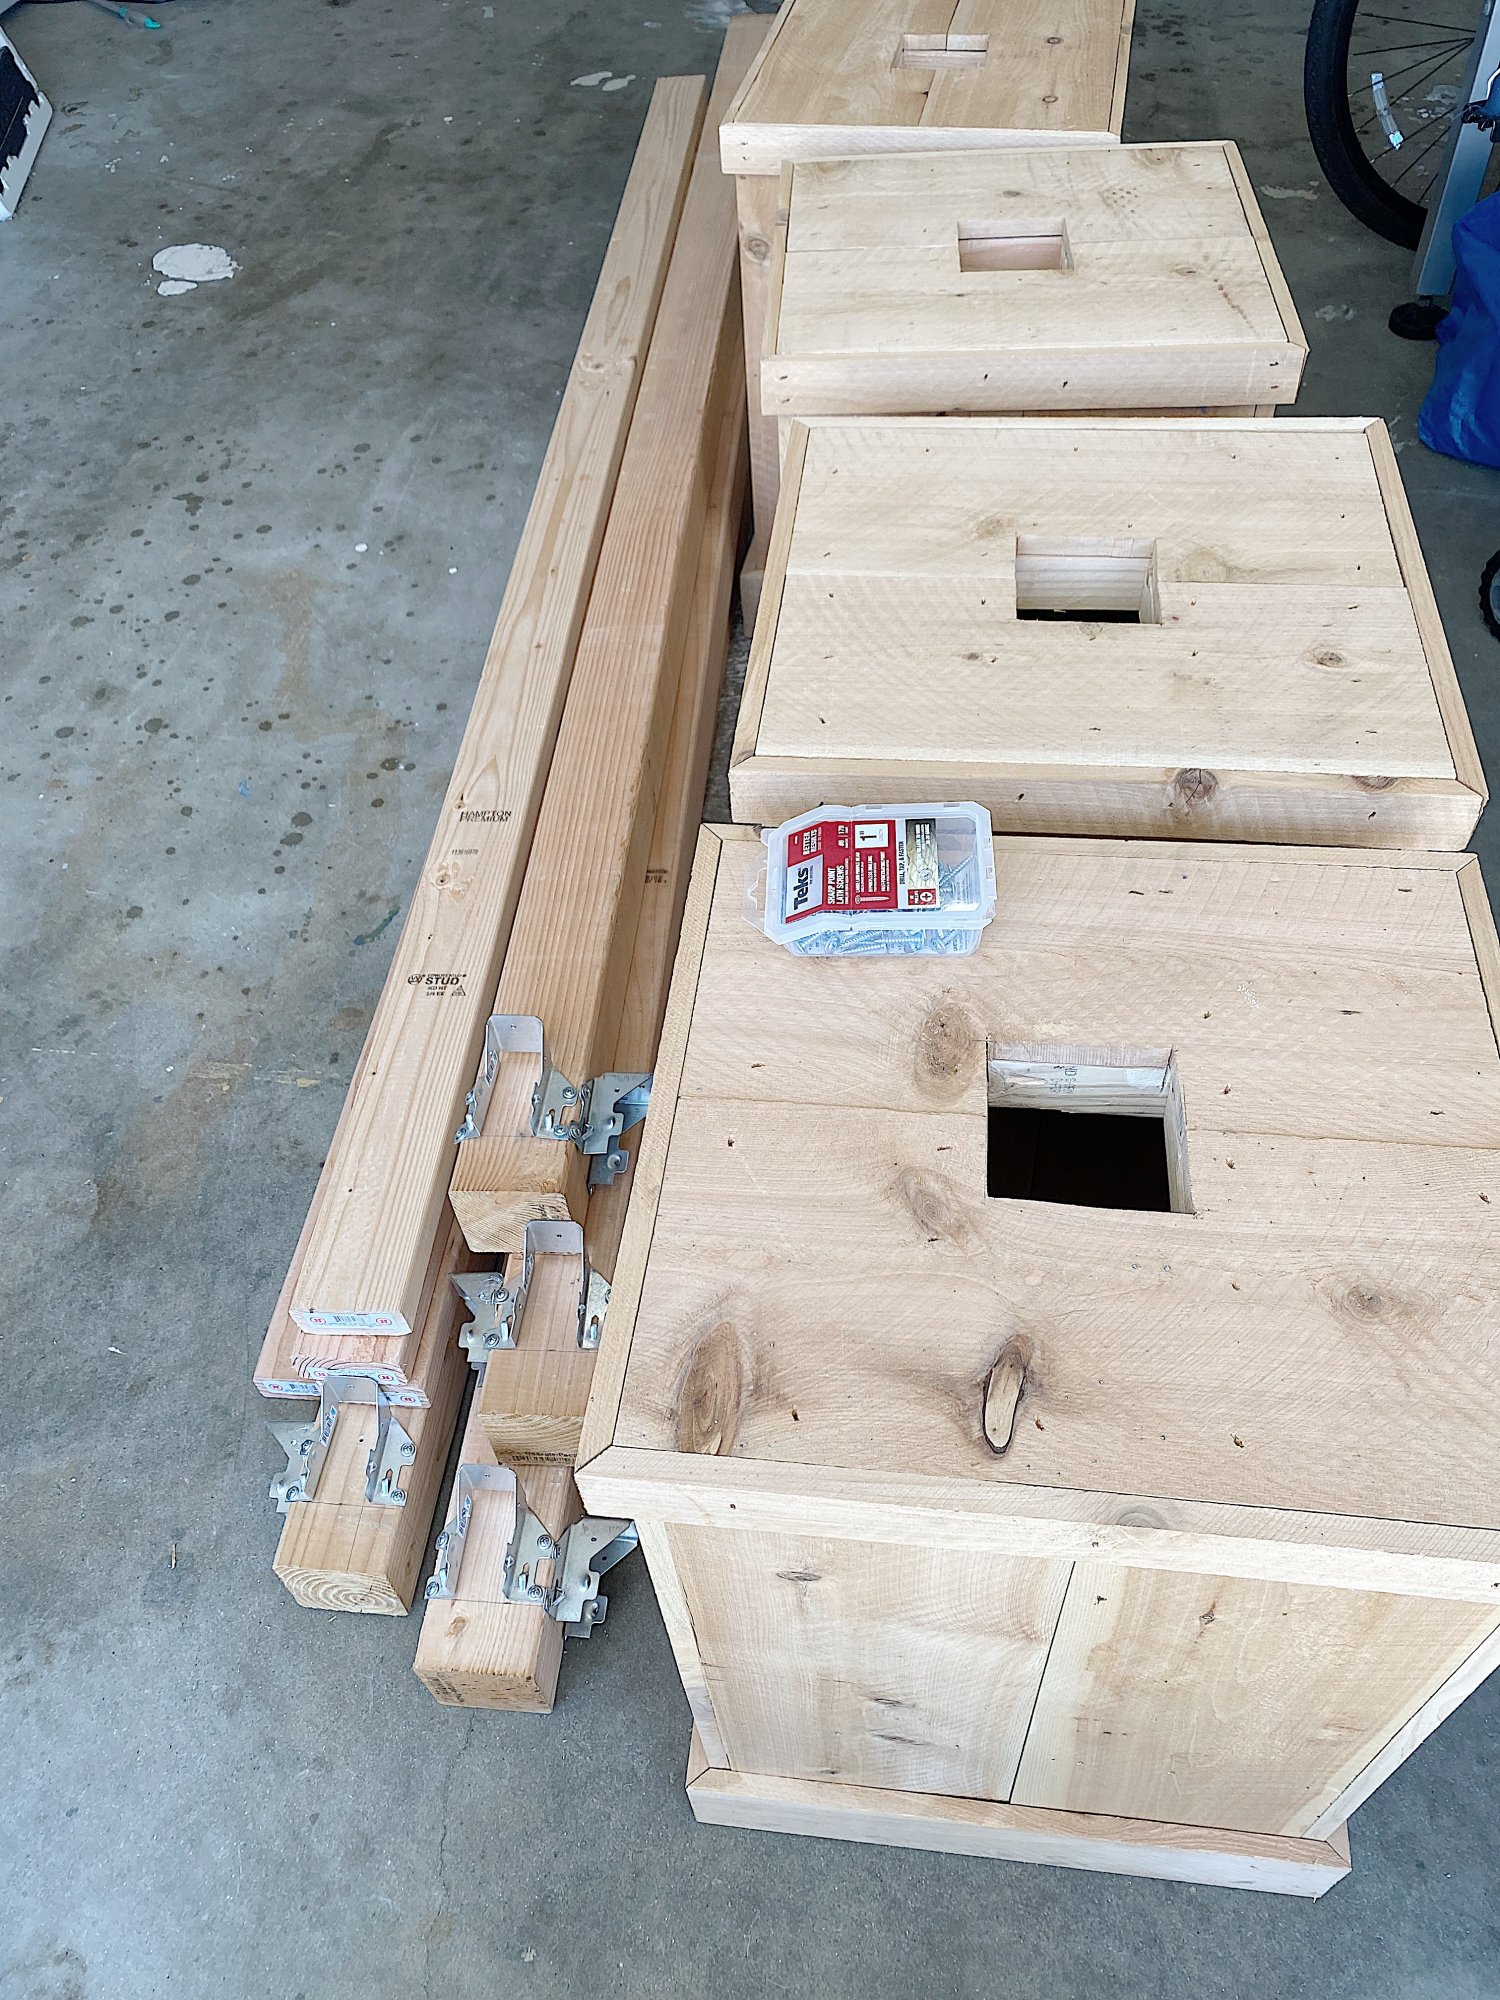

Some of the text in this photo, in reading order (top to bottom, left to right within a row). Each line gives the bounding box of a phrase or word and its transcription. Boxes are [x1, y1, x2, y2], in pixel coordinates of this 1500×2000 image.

[827, 866, 836, 885] POINT
[835, 865, 845, 890] SCREWS
[793, 867, 809, 910] Teks
[425, 976, 460, 985] STUD
